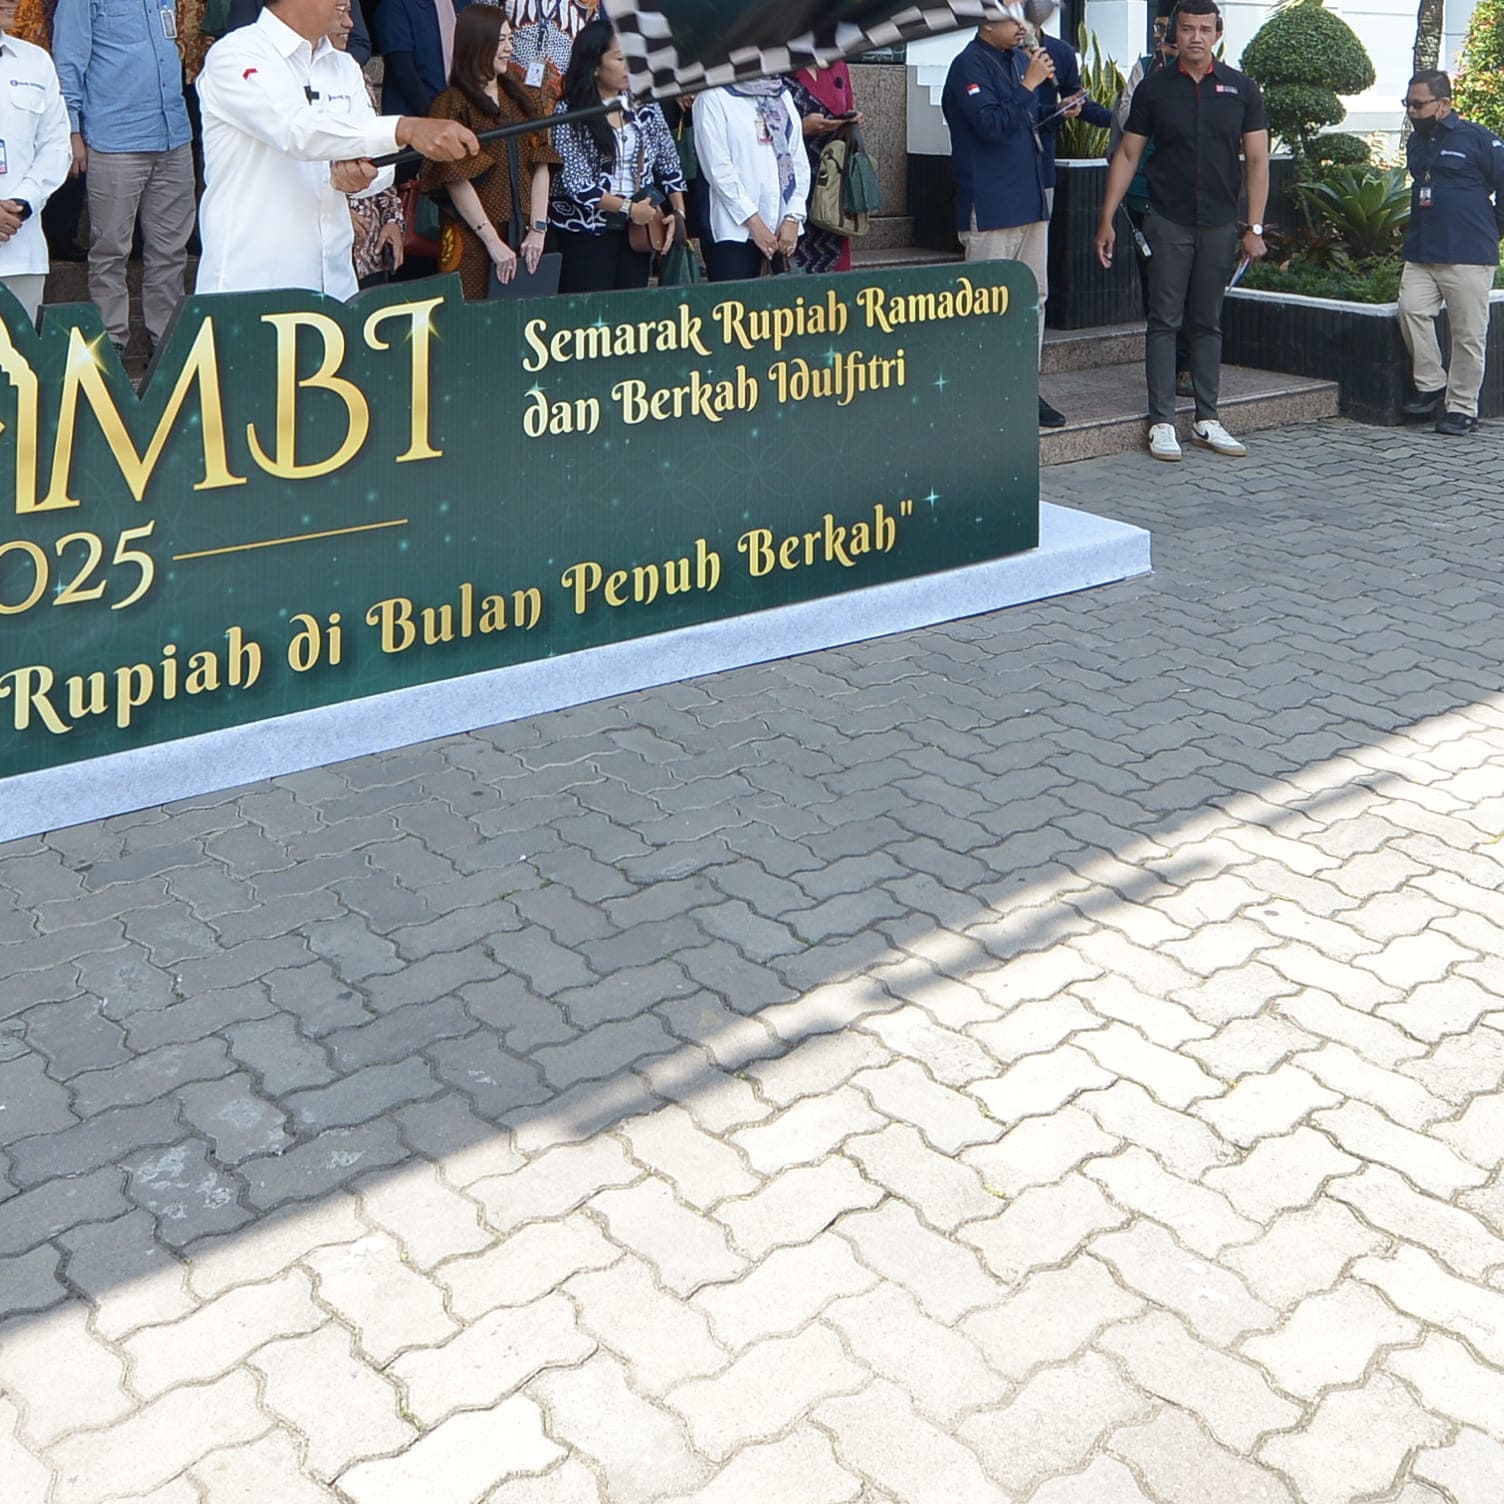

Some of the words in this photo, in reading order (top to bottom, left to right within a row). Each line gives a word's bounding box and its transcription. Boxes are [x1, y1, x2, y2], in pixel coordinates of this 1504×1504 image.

[522, 304, 712, 372] Semarak
[712, 290, 848, 351] Rupiah
[856, 277, 1009, 333] Ramadan
[522, 388, 600, 438] dan
[611, 364, 758, 422] Berkah
[768, 348, 906, 406] Idulfitri
[288, 612, 342, 672] di
[366, 582, 542, 654] Bulan
[561, 539, 721, 615] Penuh
